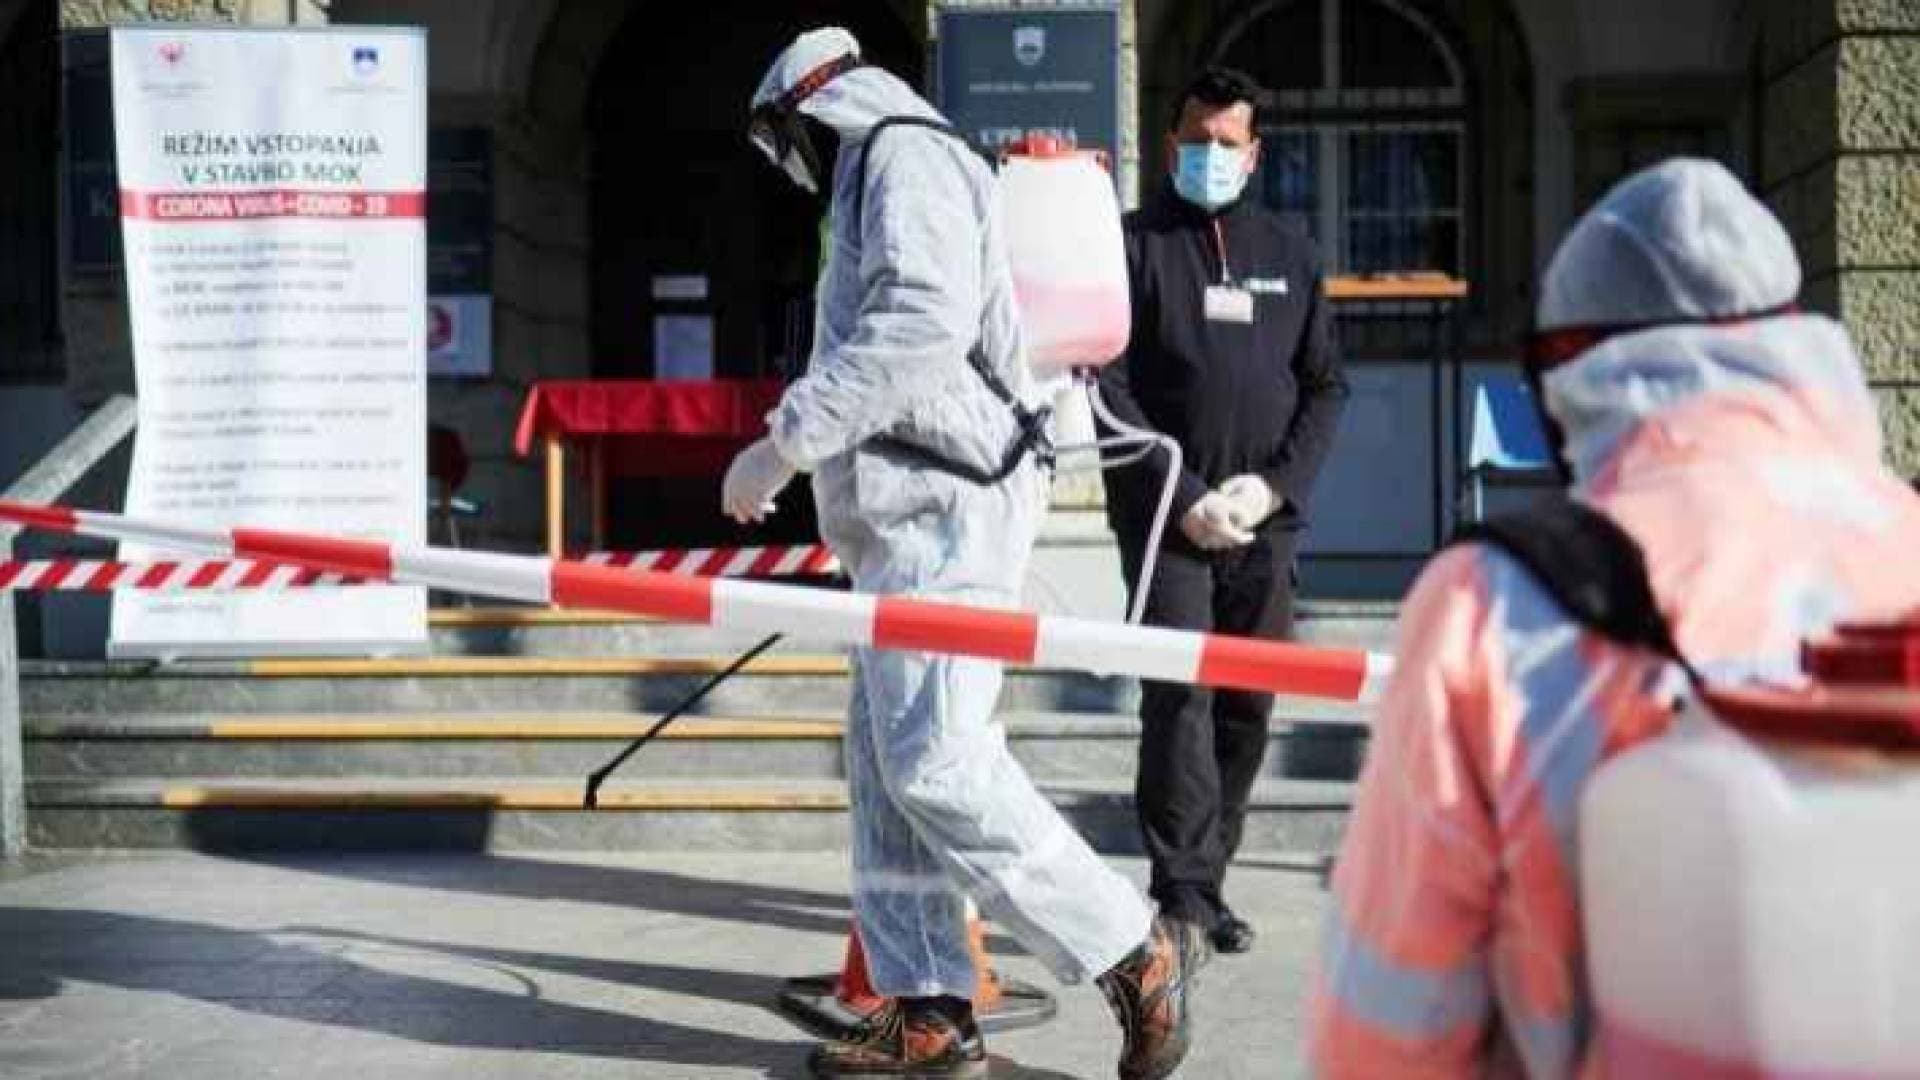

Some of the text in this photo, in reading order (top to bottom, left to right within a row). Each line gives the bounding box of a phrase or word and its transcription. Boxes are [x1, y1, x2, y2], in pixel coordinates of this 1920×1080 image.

[245, 133, 383, 155] VSTOPANJA
[182, 164, 198, 183] V
[303, 162, 364, 182] MOK
[157, 196, 233, 216] CORONA
